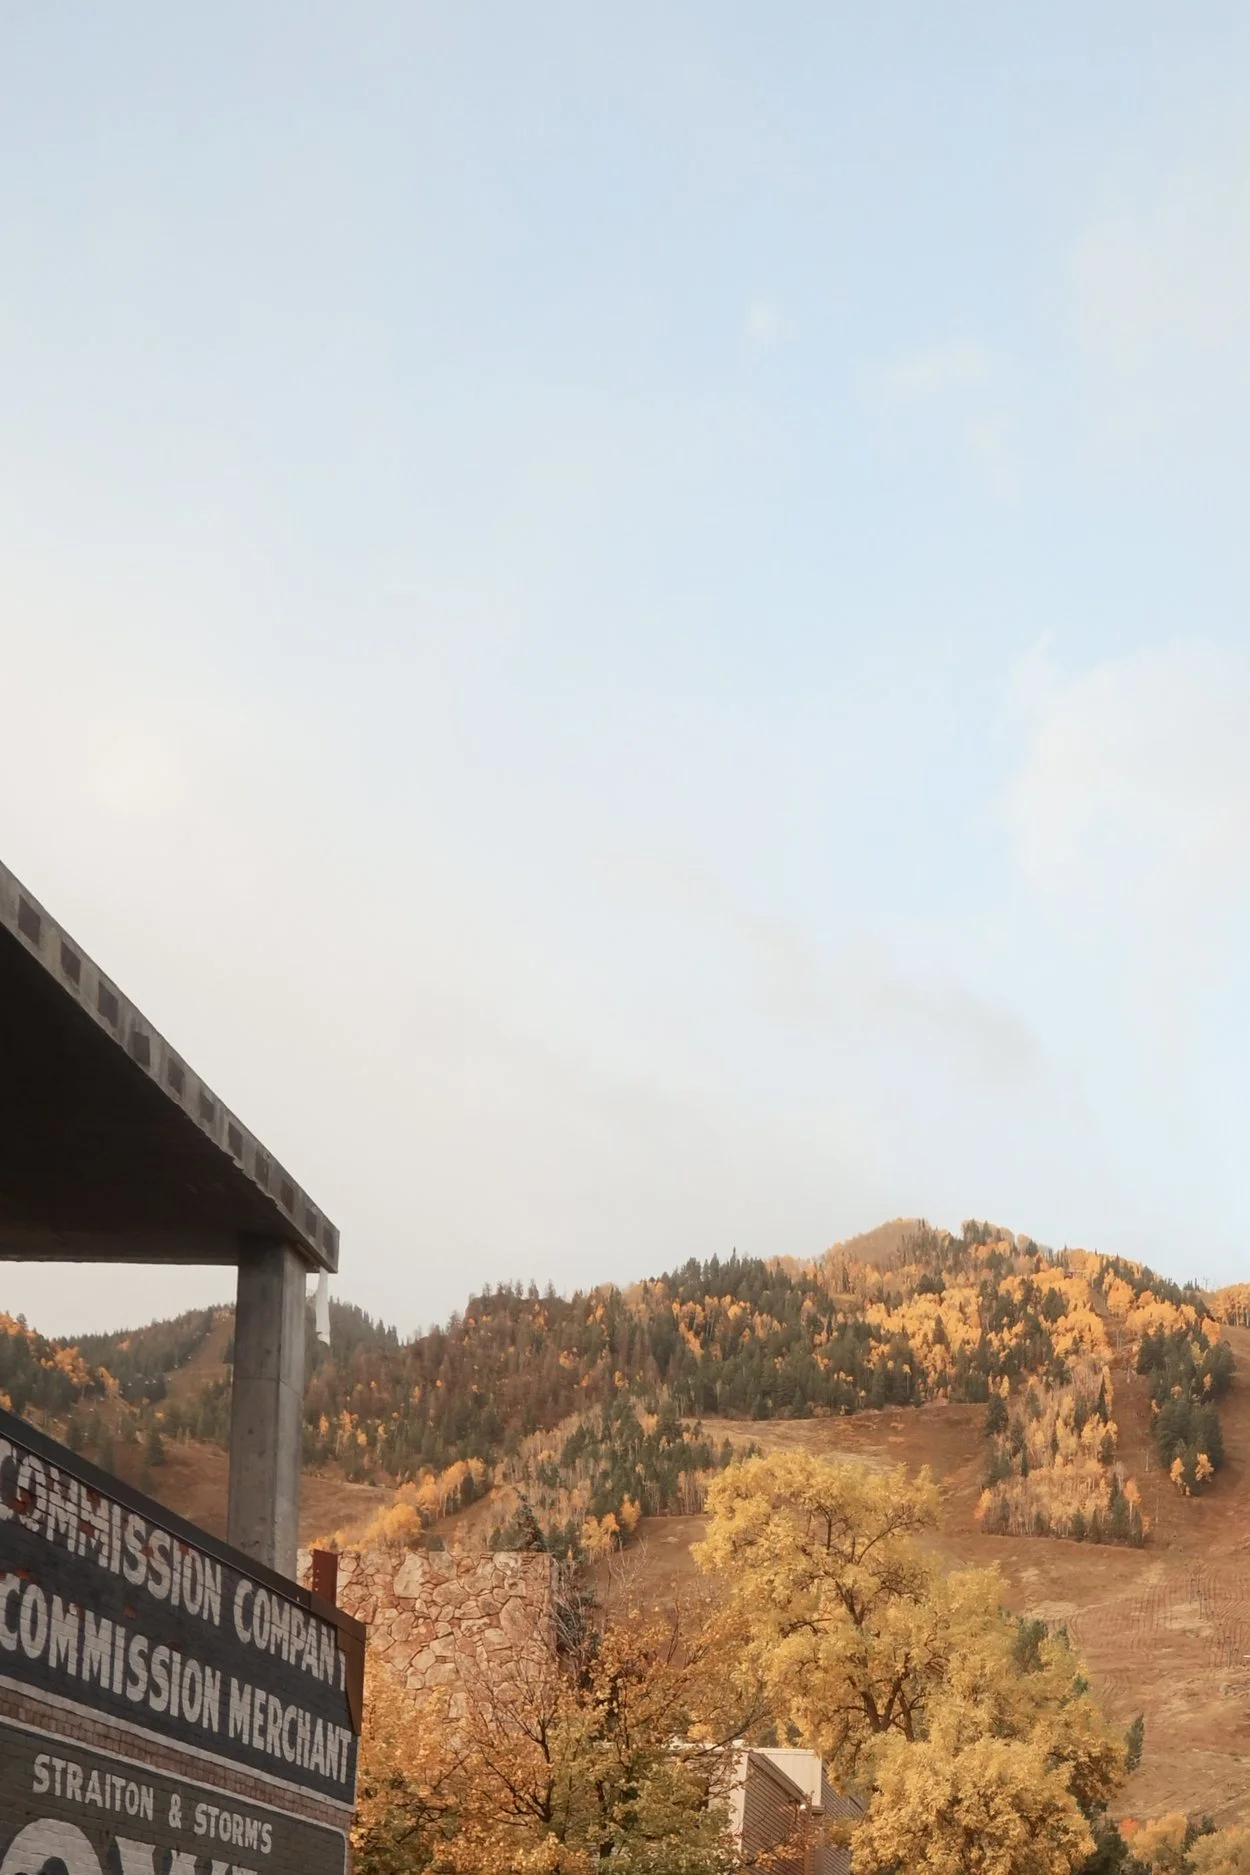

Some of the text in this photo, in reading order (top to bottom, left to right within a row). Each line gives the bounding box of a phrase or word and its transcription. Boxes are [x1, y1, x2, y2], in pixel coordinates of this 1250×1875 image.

[0, 1573, 352, 1784] COMMISSION MERCHANT
[32, 1754, 272, 1854] STRAITON & STORM'S
